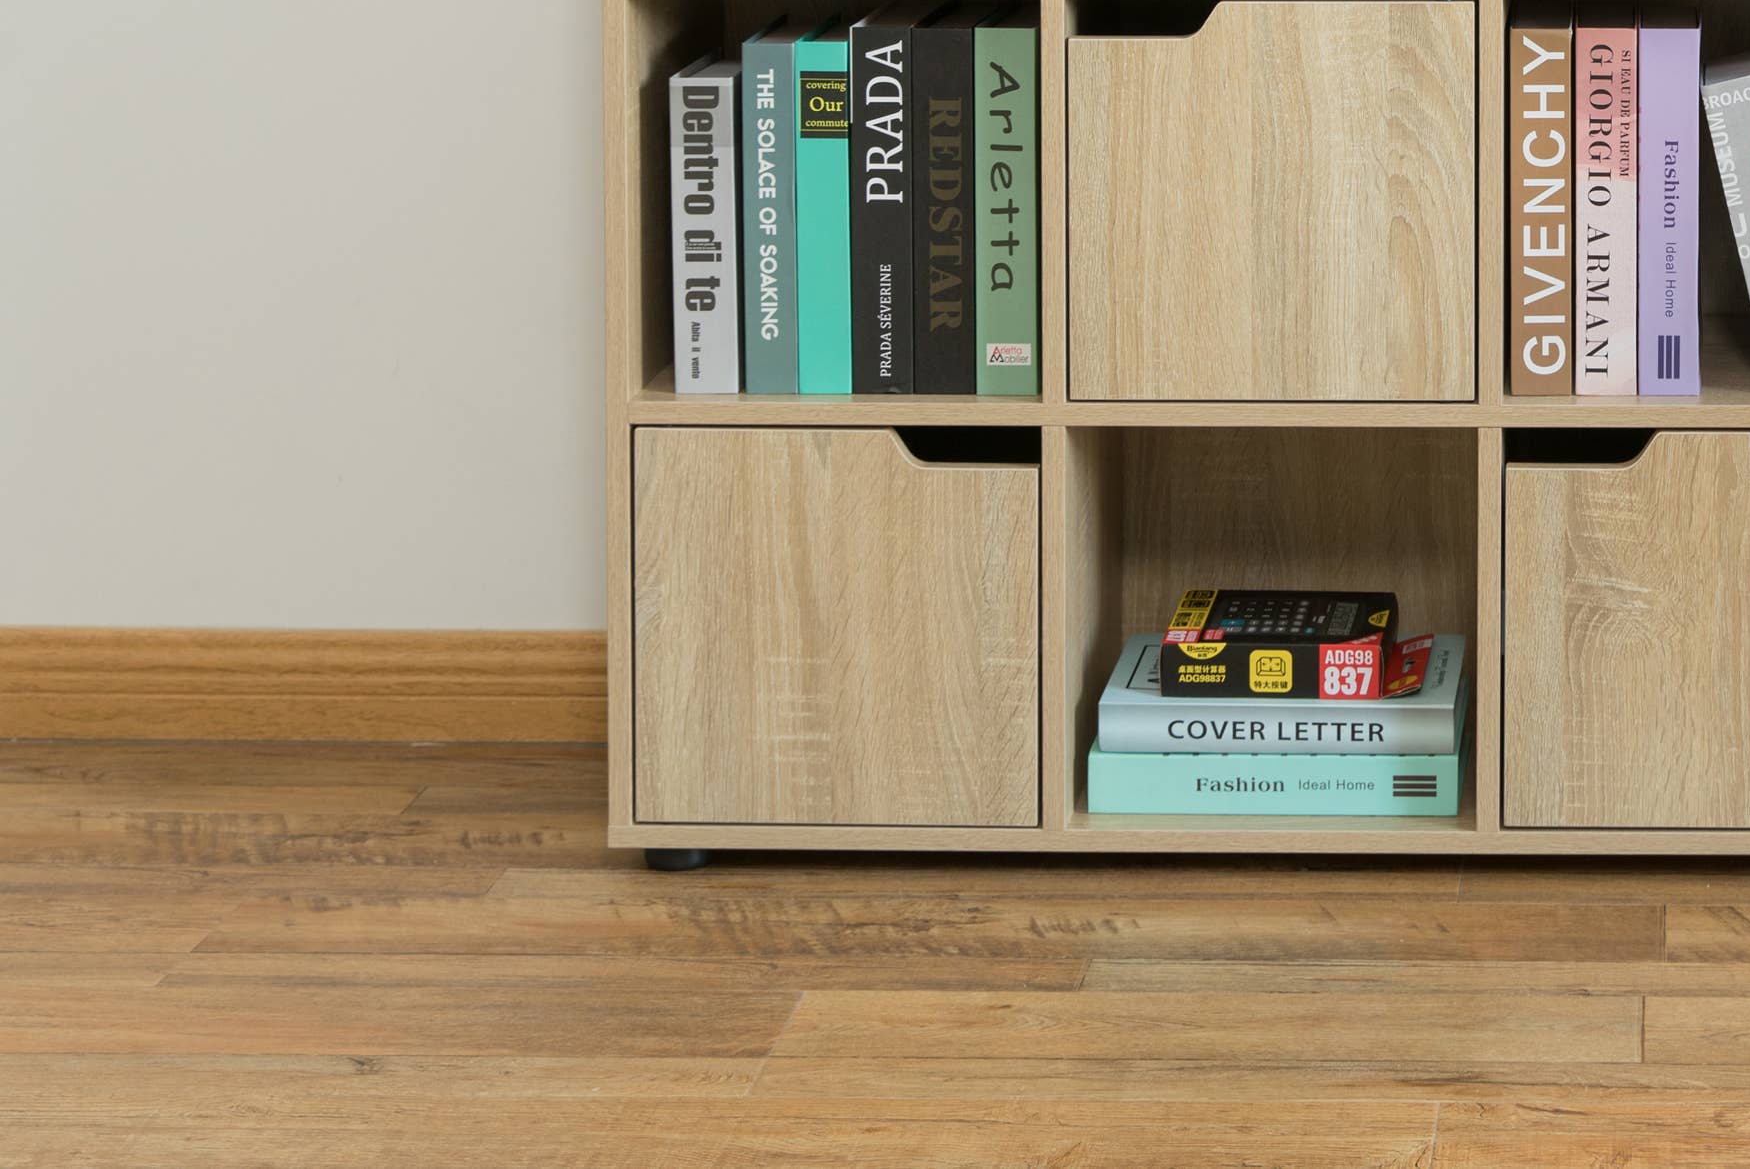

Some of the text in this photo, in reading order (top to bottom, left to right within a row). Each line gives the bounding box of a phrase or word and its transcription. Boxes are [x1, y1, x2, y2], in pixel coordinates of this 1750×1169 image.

[806, 81, 846, 92] covering
[809, 96, 844, 112] Our
[1619, 50, 1631, 177] SI EAU DE PARFUM
[683, 86, 720, 215] Dentro
[865, 40, 903, 203] PRADA
[989, 61, 1024, 292] Arletta
[1707, 112, 1743, 208] MUSEUM
[756, 68, 779, 341] THE SOLACE OF SOAKING
[1523, 36, 1566, 375] GIVENCHY
[1585, 44, 1614, 377] GIORGIO ARMANI
[1664, 140, 1681, 318] Fashion Ideal Home
[684, 230, 722, 262] di
[685, 276, 721, 311] te
[877, 263, 892, 377] PRADA SÉVERINE
[691, 357, 700, 379] vento
[1178, 674, 1226, 684] ADG98837
[1323, 666, 1373, 696] 837
[1324, 649, 1374, 666] ADG98
[1167, 719, 1385, 743] COVER LETTER
[1195, 777, 1376, 793] Fashion Ideal Home
